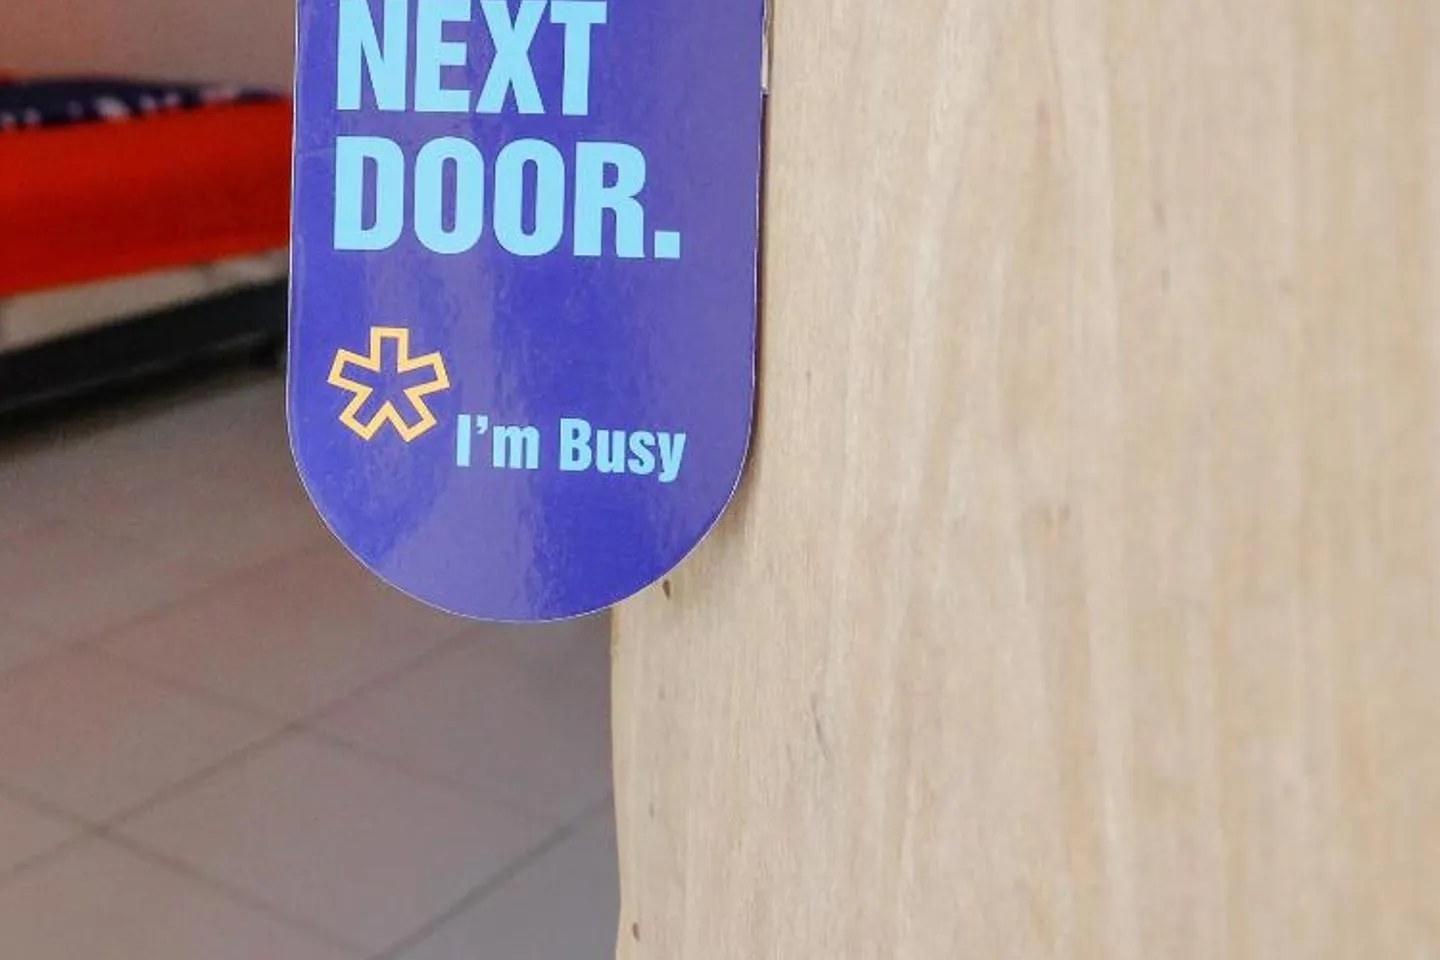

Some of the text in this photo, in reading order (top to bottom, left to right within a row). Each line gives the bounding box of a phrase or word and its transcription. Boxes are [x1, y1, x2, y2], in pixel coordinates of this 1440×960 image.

[333, 135, 681, 260] DOOR.
[455, 413, 687, 483] I'm Busy
